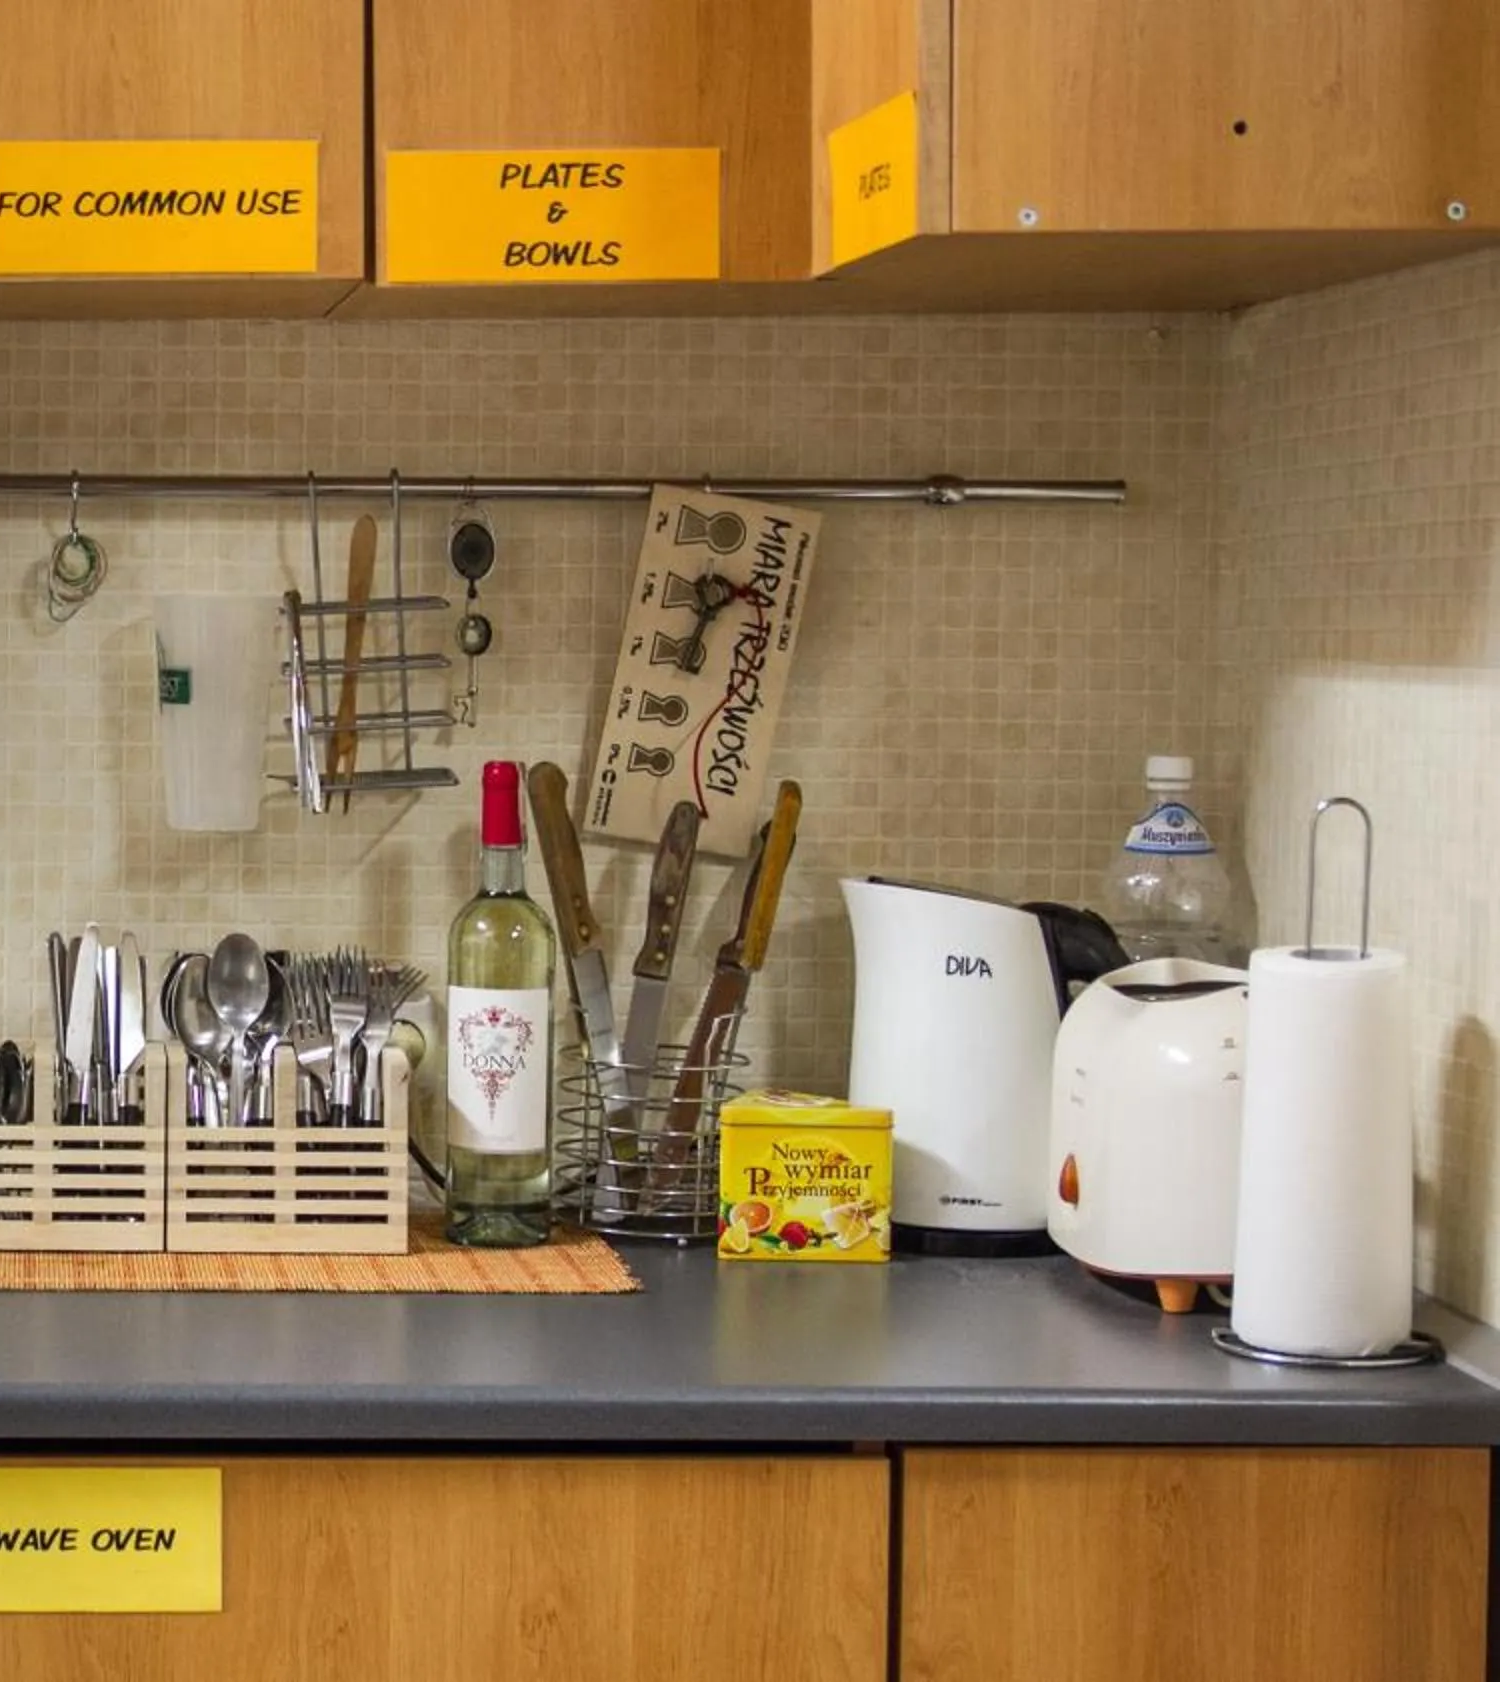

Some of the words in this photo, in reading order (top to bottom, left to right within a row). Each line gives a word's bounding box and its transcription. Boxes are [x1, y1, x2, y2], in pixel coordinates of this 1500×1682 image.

[499, 162, 626, 189] PLATES
[73, 189, 227, 217] COMMON
[235, 189, 303, 216] USE
[547, 200, 569, 224] &
[504, 241, 622, 267] BOWLS
[743, 515, 792, 609] MIARA
[946, 955, 993, 978] DIVA
[462, 1054, 526, 1070] DONNA
[771, 1142, 830, 1161] Nowy
[784, 1161, 874, 1185] wymiar
[90, 1528, 177, 1552] OVEN
